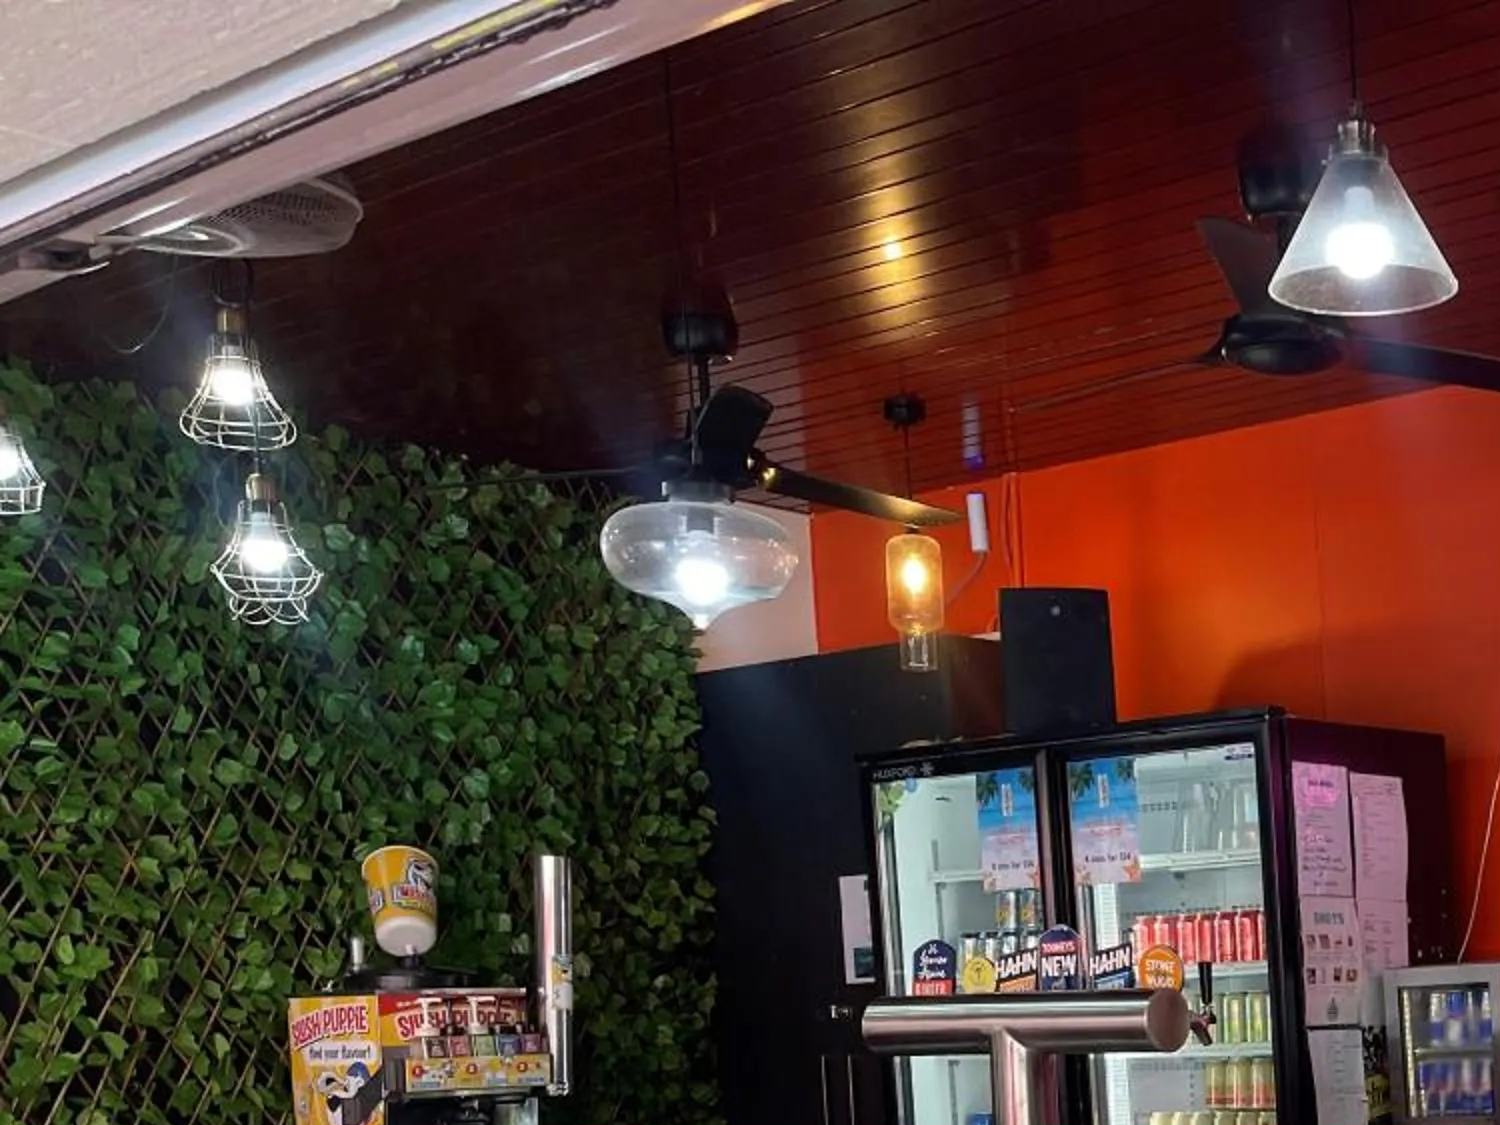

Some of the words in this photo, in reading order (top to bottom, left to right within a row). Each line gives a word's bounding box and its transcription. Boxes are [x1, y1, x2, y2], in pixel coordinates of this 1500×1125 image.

[994, 951, 1037, 978] HAHN
[1042, 955, 1077, 977] NEW
[1090, 947, 1131, 976] HAHN
[323, 1006, 367, 1033] PUPPIE
